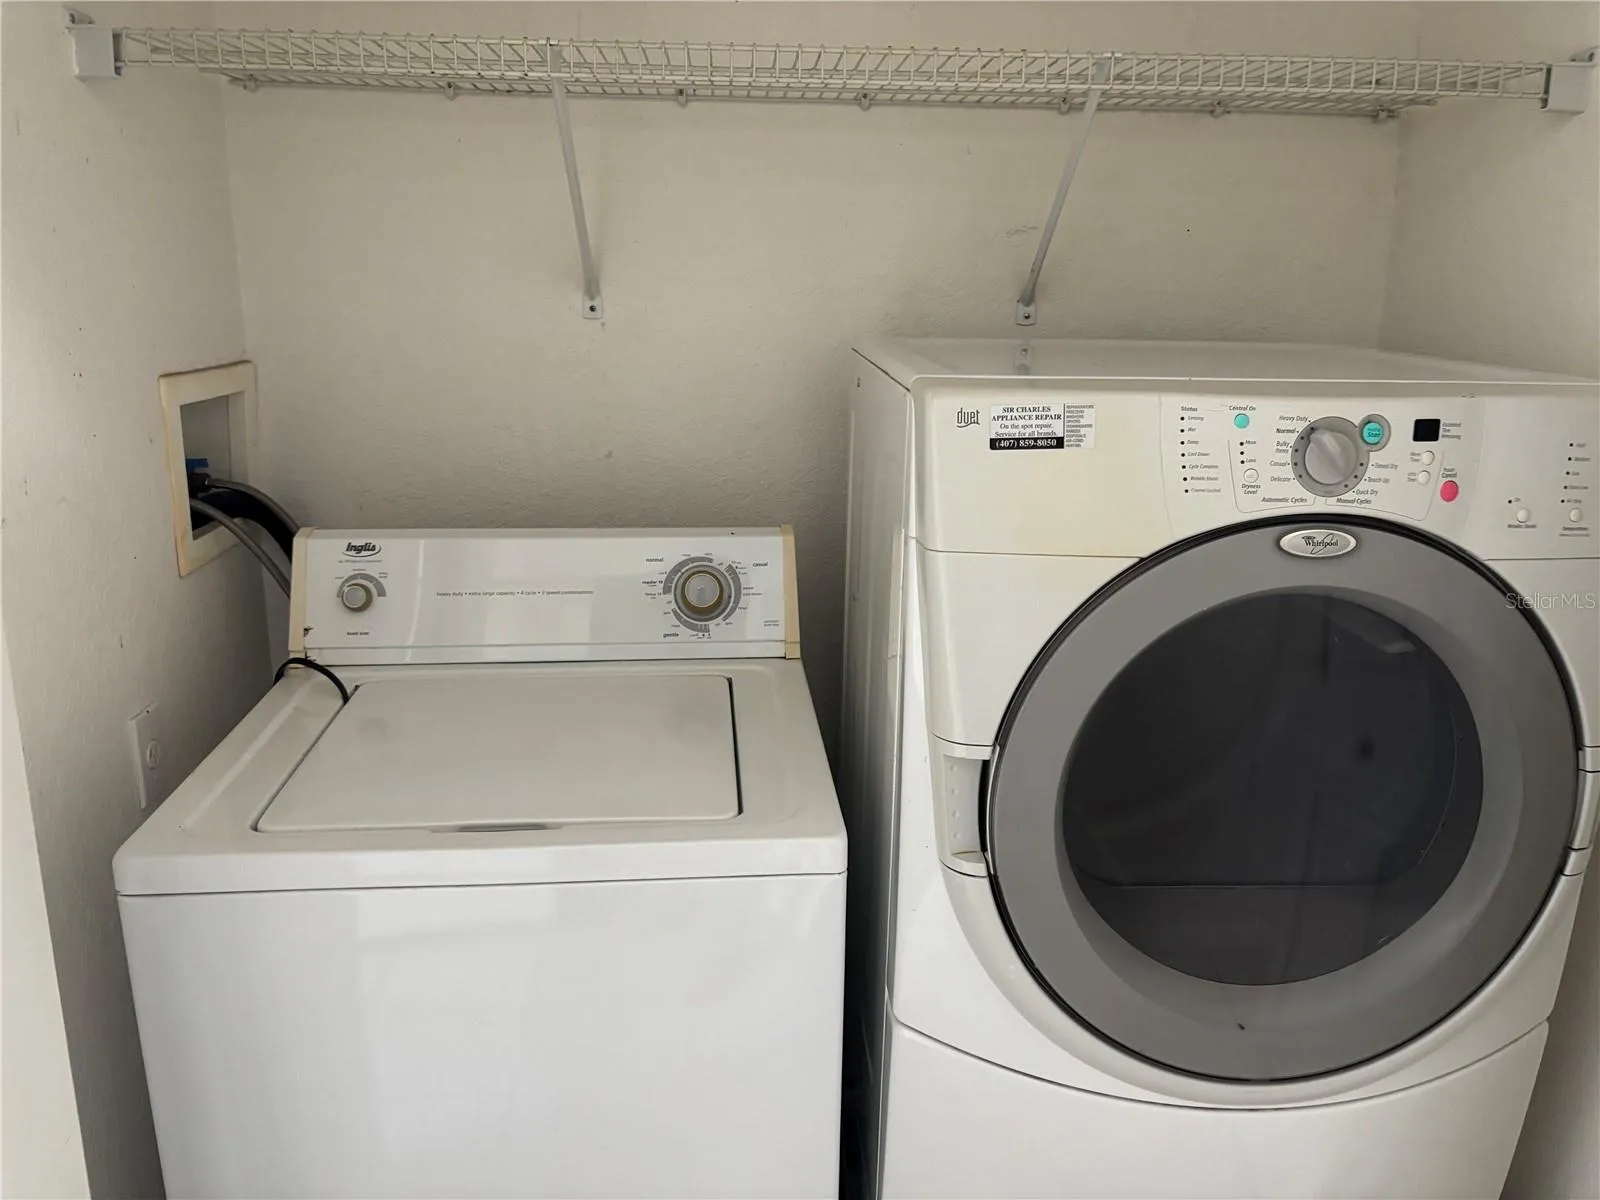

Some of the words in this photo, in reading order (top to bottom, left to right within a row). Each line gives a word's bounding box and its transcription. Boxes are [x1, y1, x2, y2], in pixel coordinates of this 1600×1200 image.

[956, 407, 980, 427] duet
[1034, 422, 1054, 430] repair.
[996, 440, 1018, 448] (407)
[1019, 439, 1057, 447] 859-8050
[346, 542, 376, 554] Inglis
[1304, 538, 1339, 548] Whirlpool
